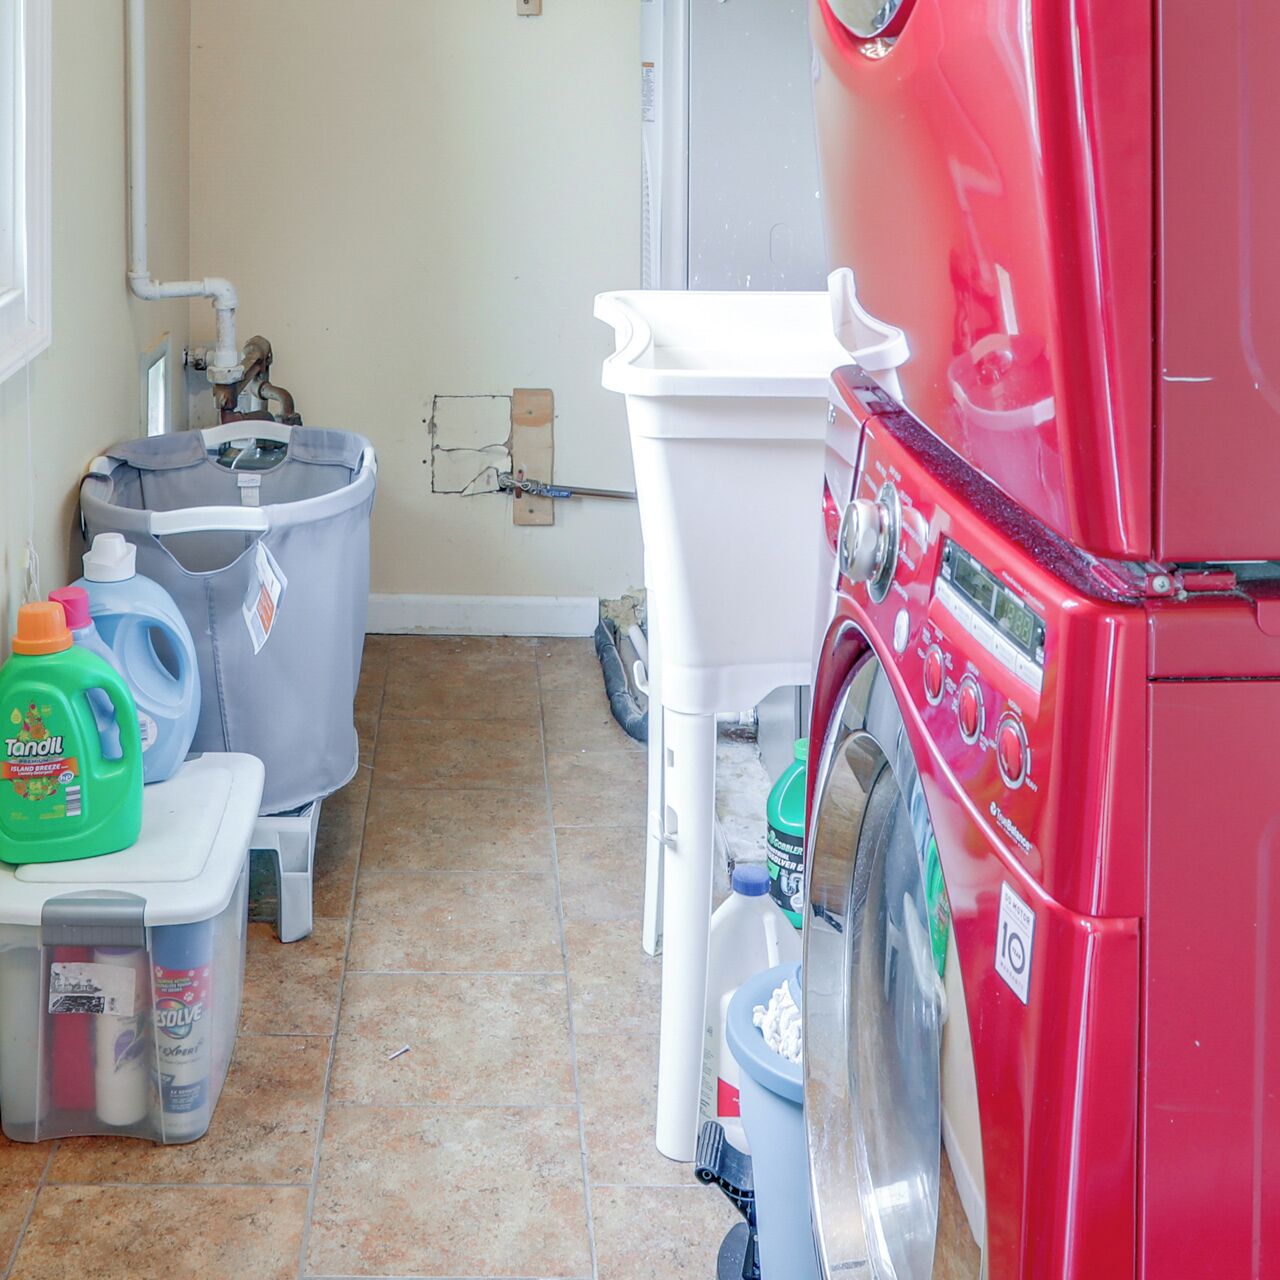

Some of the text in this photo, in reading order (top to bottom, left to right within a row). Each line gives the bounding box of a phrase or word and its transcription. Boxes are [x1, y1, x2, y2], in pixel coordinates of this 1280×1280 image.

[5, 736, 64, 757] Tandil
[35, 763, 62, 772] BREEZE
[773, 838, 803, 856] GOBBLER
[1012, 903, 1031, 926] MOTOR
[1001, 921, 1026, 975] 10
[155, 1002, 202, 1028] ESOLVE
